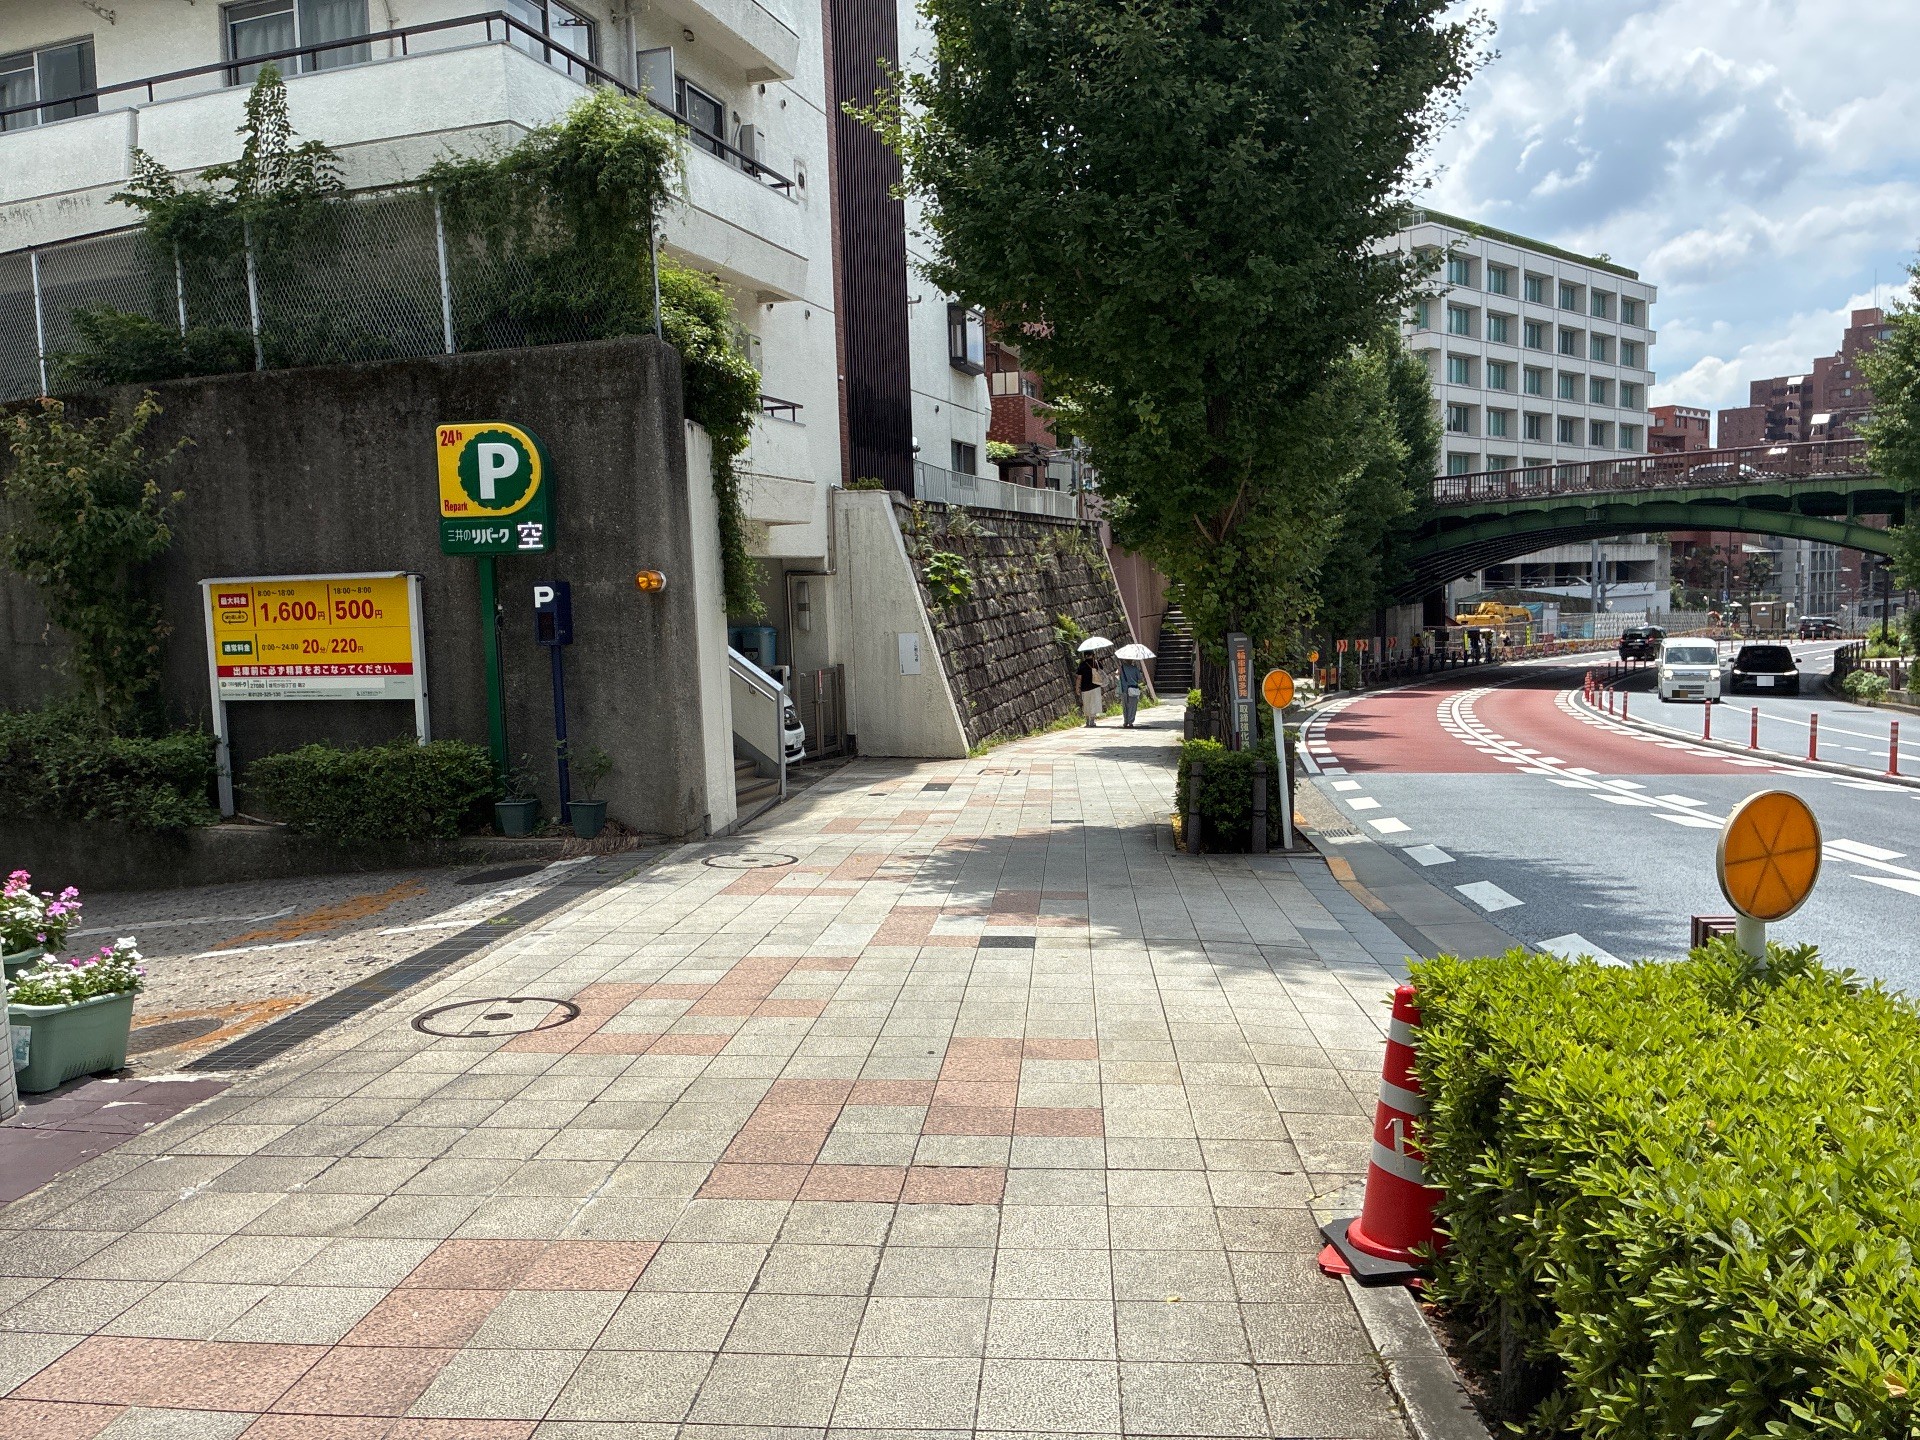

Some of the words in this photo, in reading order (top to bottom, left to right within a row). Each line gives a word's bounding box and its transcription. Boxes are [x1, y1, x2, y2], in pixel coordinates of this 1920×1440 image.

[440, 429, 463, 447] 24h
[477, 442, 519, 500] P
[443, 499, 468, 513] Repark
[447, 528, 509, 544] 三井のリパーク
[516, 521, 544, 549] 空
[220, 596, 247, 606] 最大料金
[533, 585, 555, 608] P
[335, 599, 383, 620] 500円
[233, 666, 397, 676] 出庫前に必ず精算をおこなってください。
[1236, 645, 1248, 697] 二輪車事故多発
